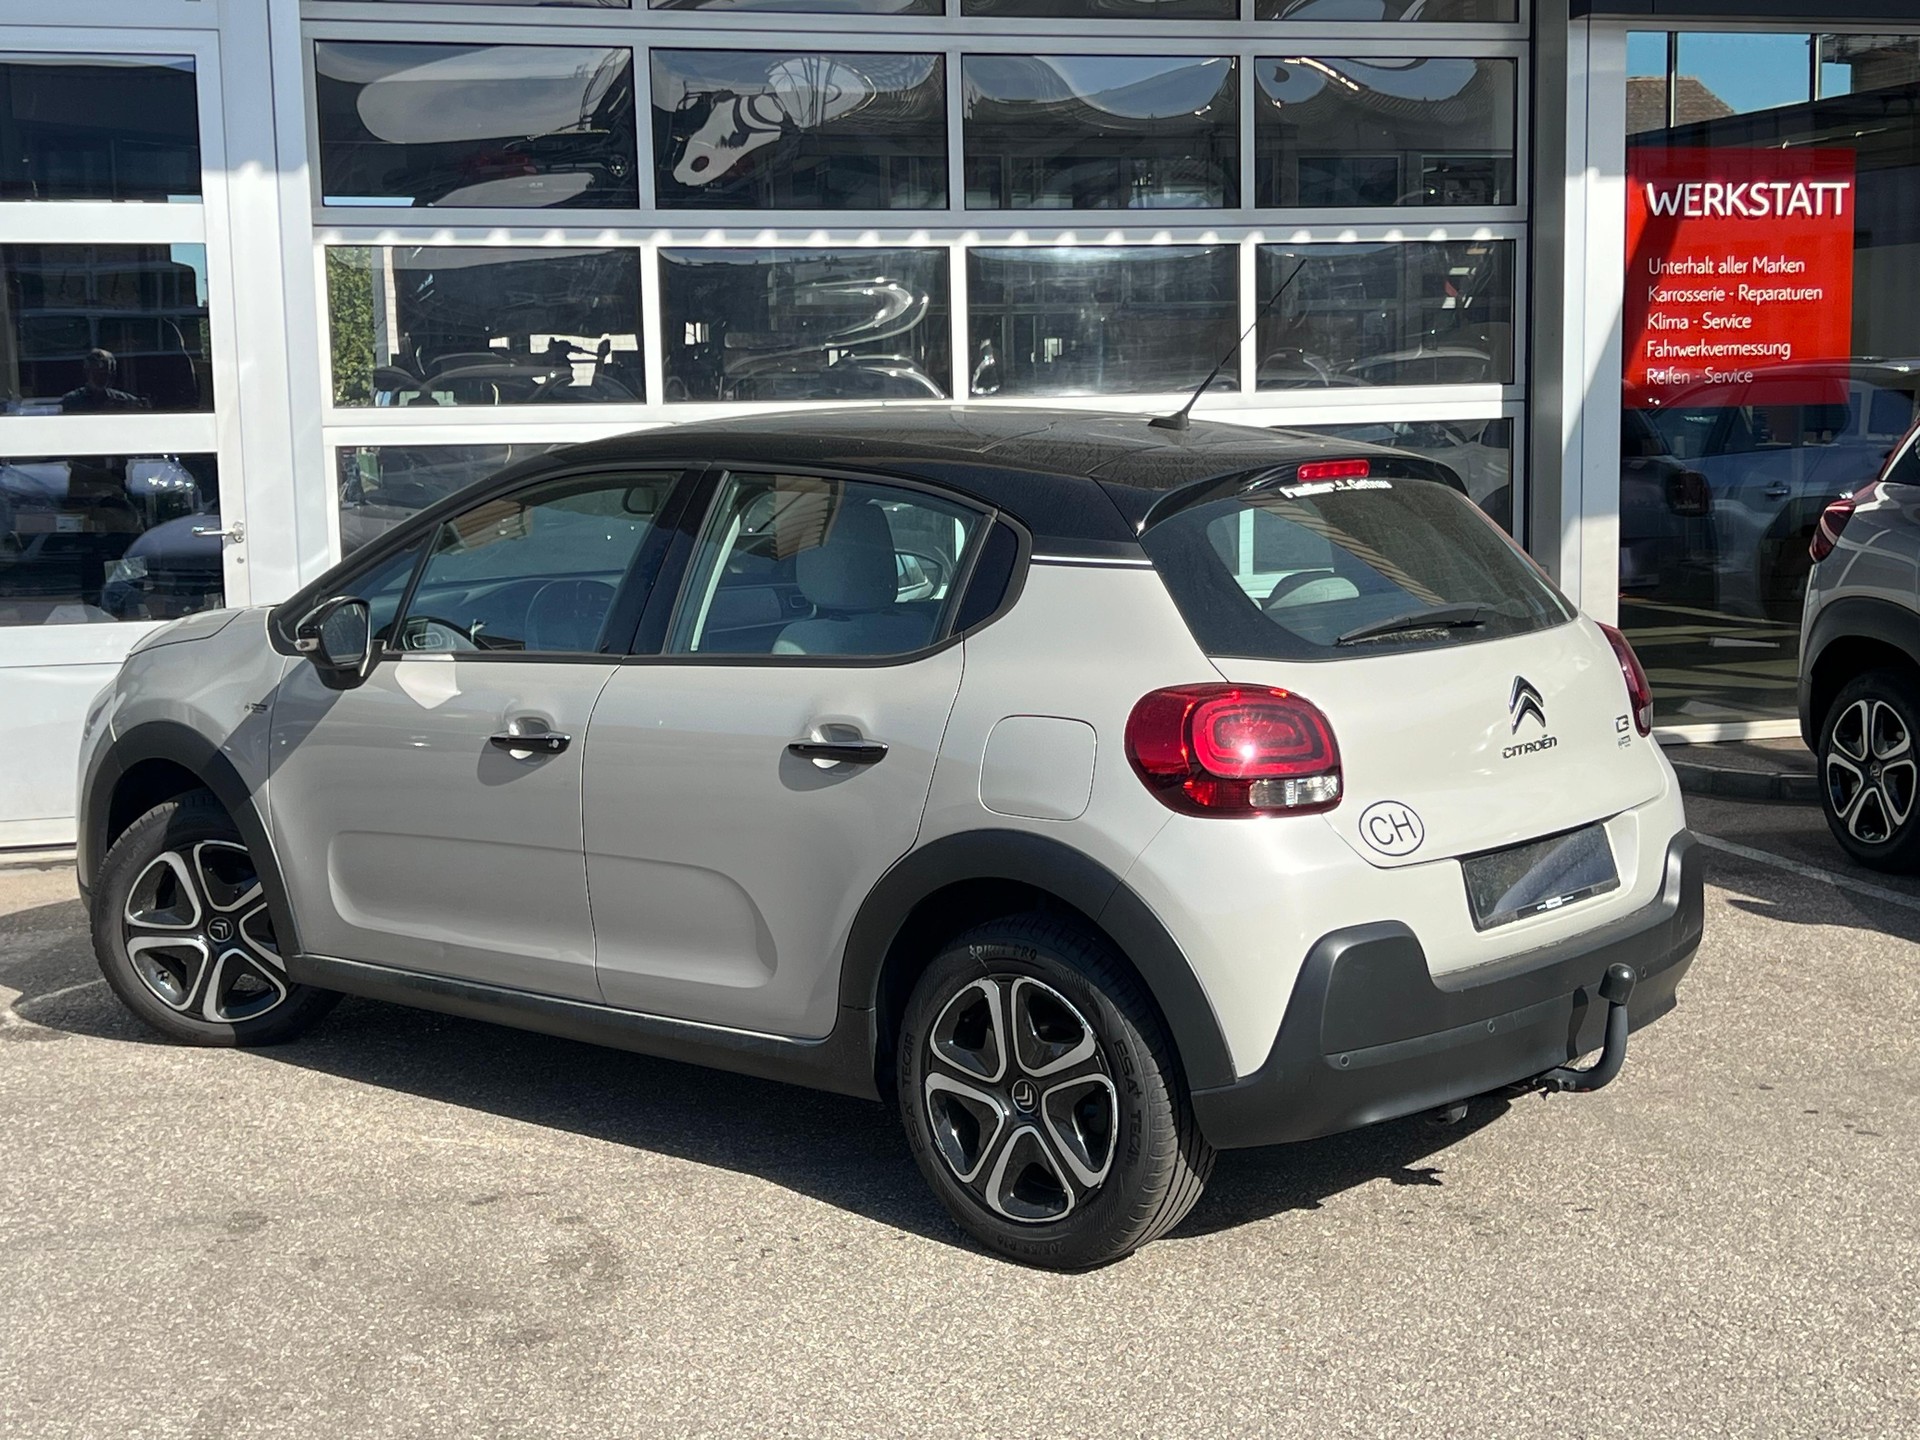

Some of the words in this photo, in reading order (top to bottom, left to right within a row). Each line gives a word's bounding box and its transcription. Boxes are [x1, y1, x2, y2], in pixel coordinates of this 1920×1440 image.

[1646, 182, 1850, 217] WERKSTATT
[1648, 256, 1715, 275] Unterhalt
[1718, 256, 1748, 274] aller
[1752, 255, 1805, 274] Marken
[1648, 285, 1725, 303] Karrosserie
[1738, 284, 1823, 305] Reparaturen
[1647, 312, 1689, 330] Klima
[1702, 312, 1752, 330] Service
[1646, 339, 1791, 360] Fahrwerkvermessung
[1646, 366, 1690, 385] Reifen
[1704, 366, 1753, 384] Service
[1369, 810, 1417, 846] CH
